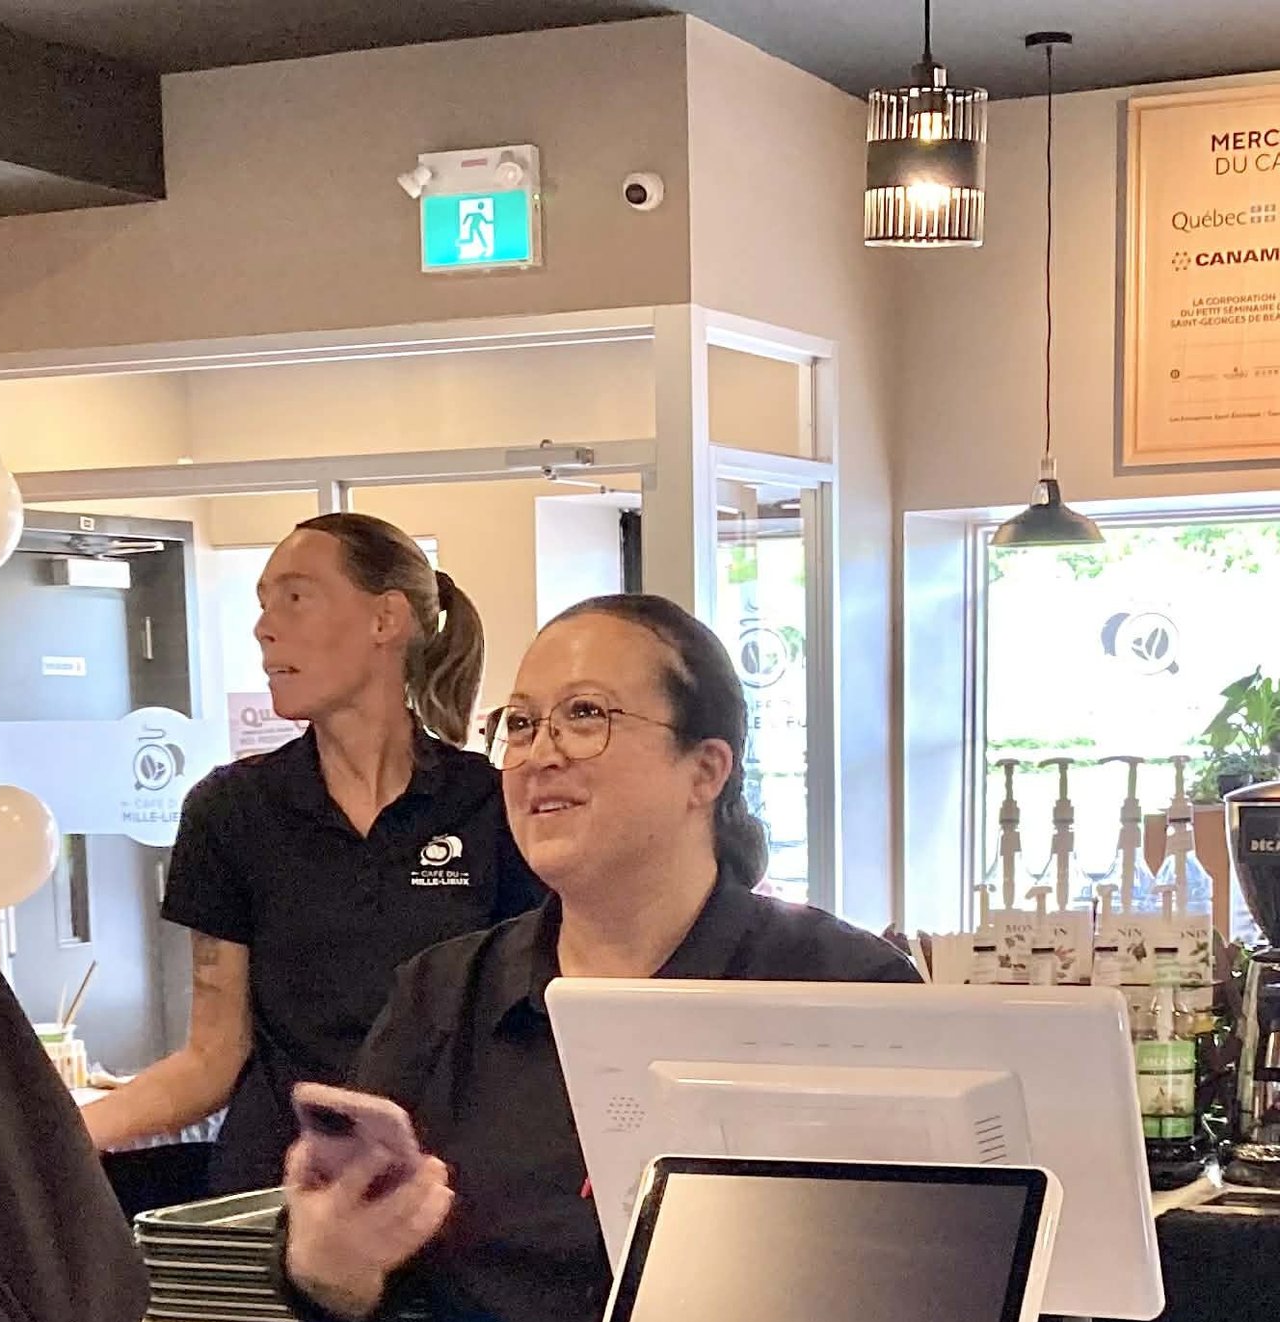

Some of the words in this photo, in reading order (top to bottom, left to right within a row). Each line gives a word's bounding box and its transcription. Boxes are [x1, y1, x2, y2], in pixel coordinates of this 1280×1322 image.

[1215, 156, 1248, 176] DU
[1171, 209, 1247, 233] Québec
[1195, 248, 1280, 266] CANAM
